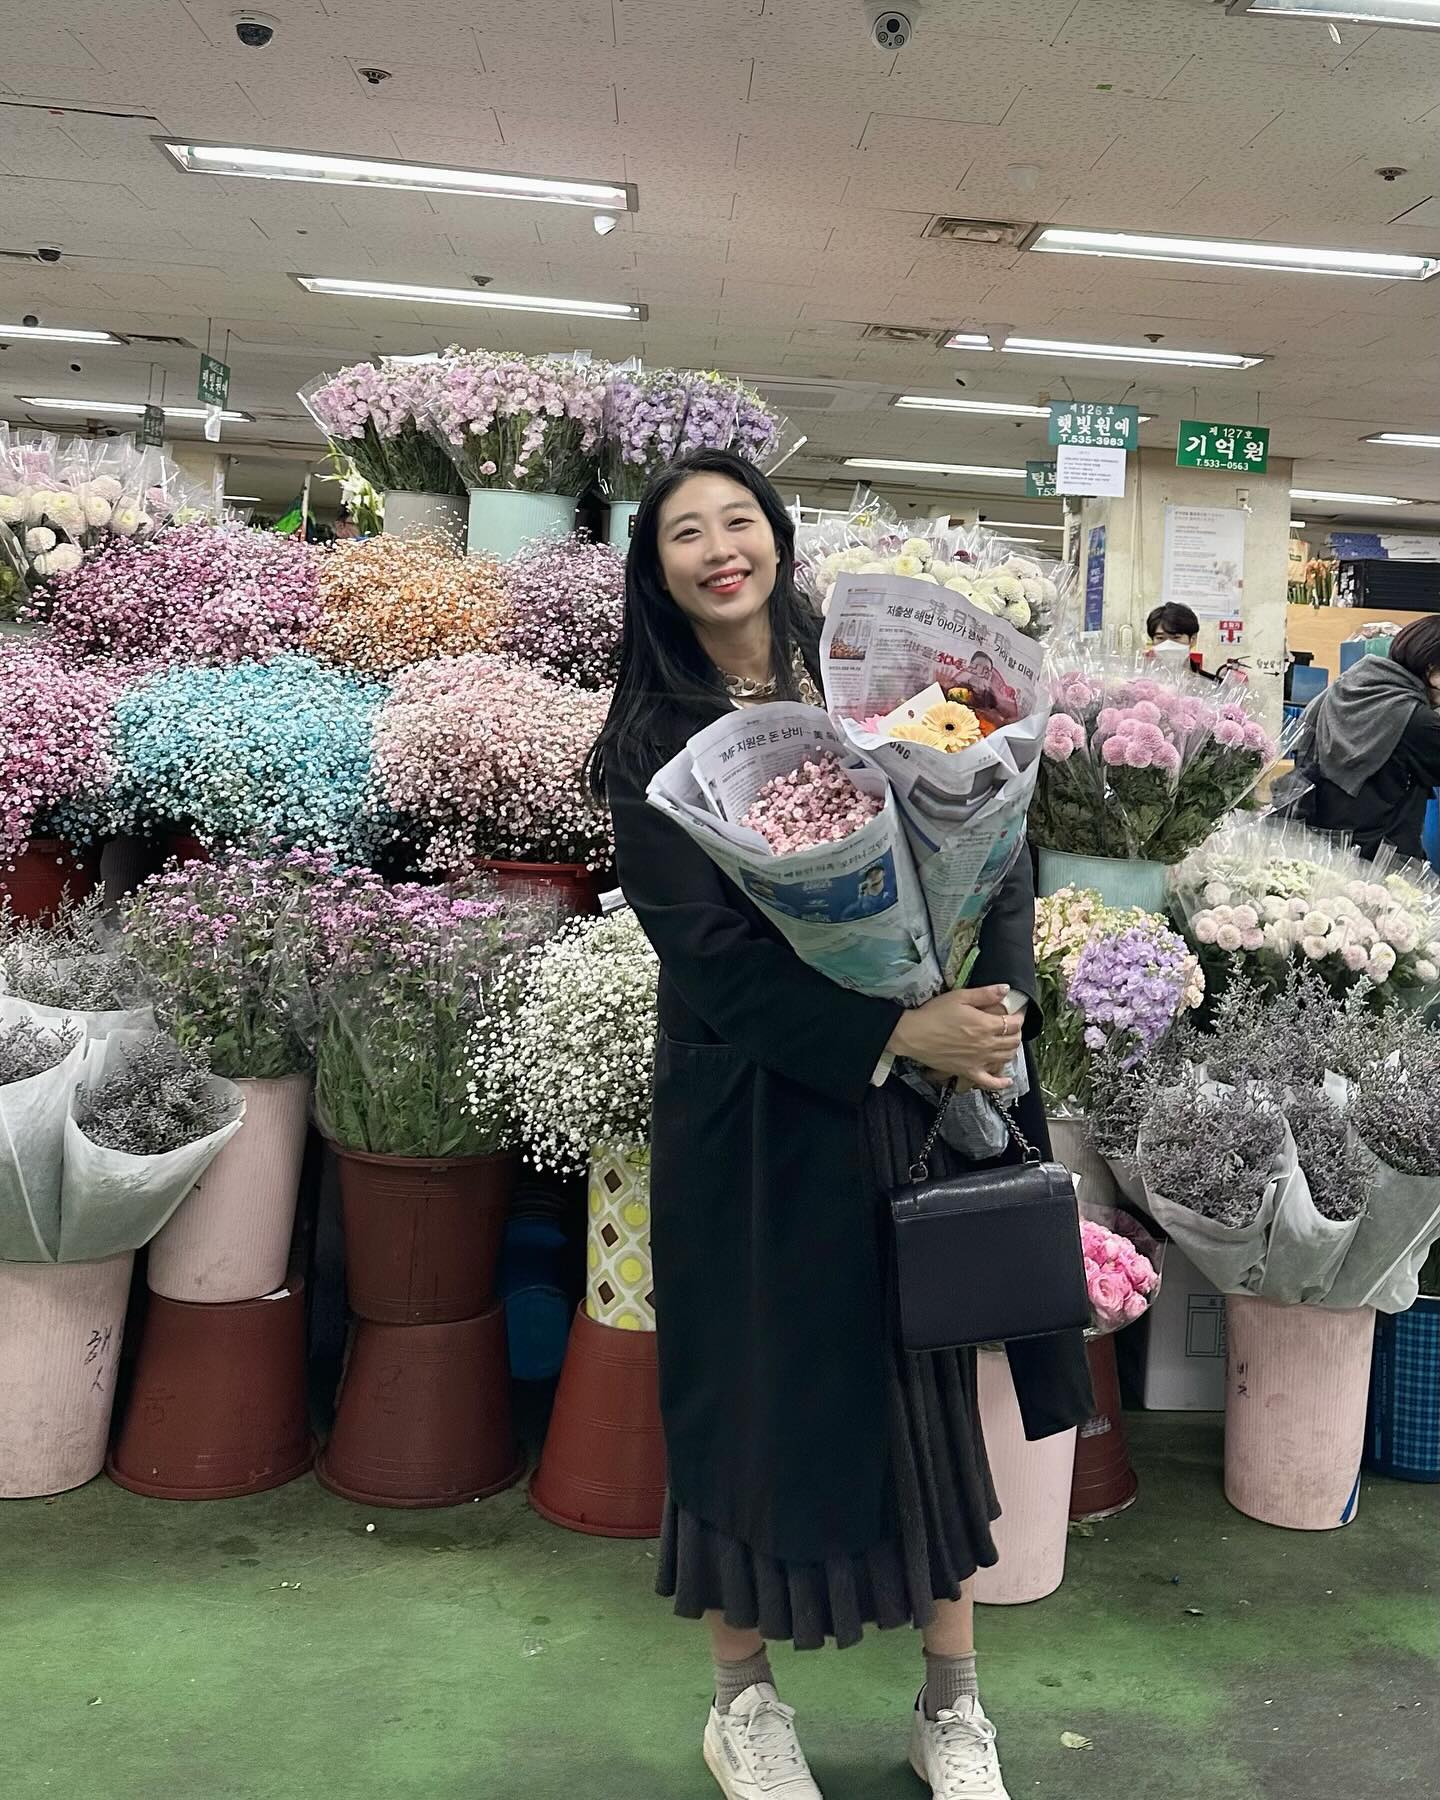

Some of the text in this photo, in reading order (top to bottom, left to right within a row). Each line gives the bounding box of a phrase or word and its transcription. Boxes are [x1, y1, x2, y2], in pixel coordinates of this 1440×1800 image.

[1057, 413, 1130, 438] 햇빛원예
[1185, 434, 1264, 462] 기억원
[1196, 458, 1249, 471] T.533-0563
[886, 605, 913, 619] 저출생
[913, 610, 934, 626] 해법
[737, 734, 767, 752] 지원은
[769, 730, 780, 743] 돈
